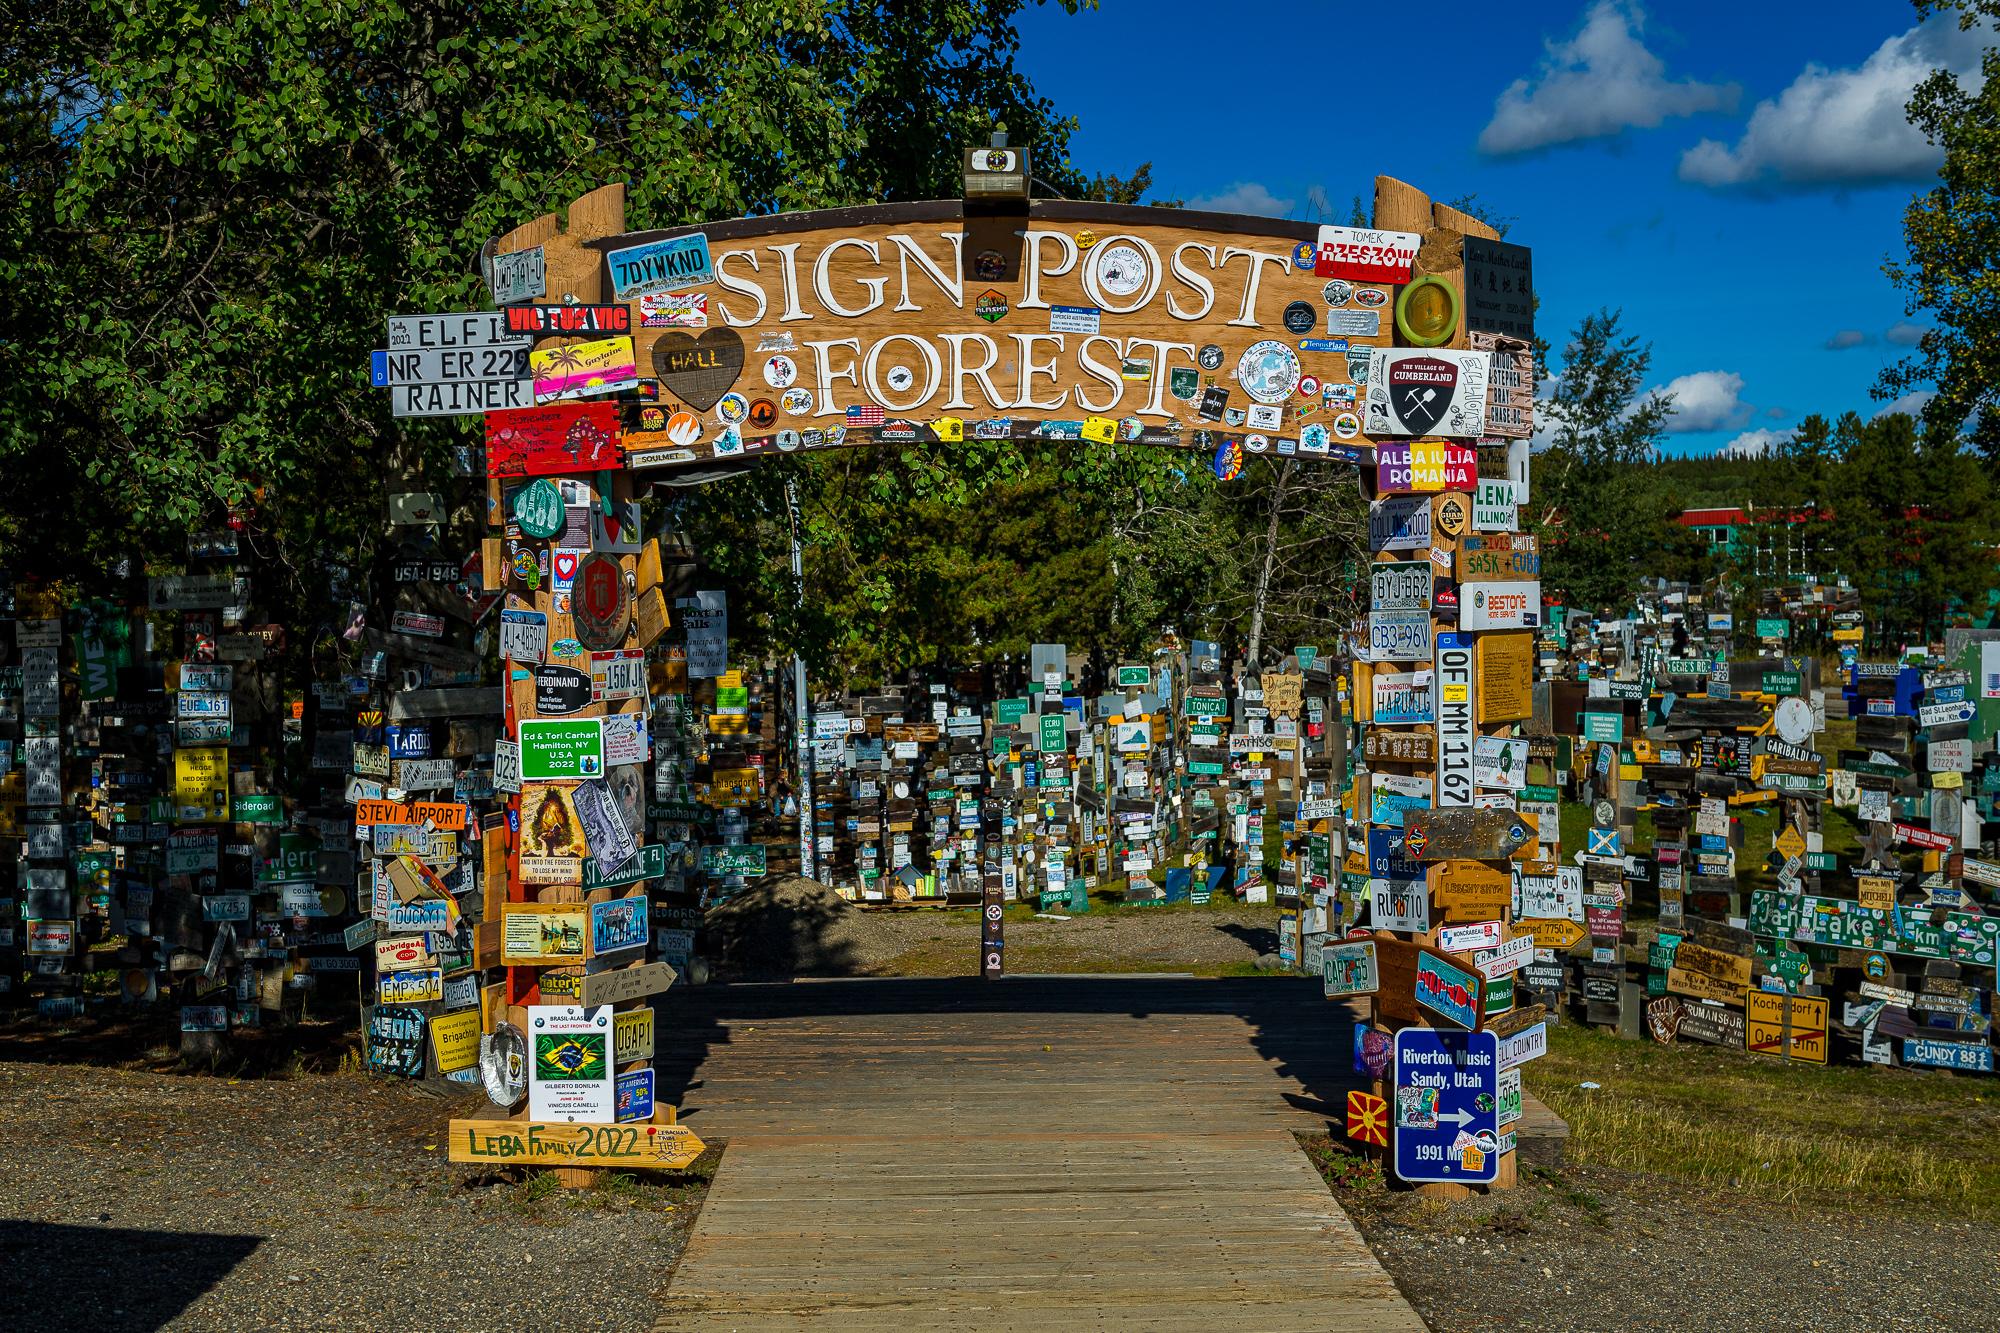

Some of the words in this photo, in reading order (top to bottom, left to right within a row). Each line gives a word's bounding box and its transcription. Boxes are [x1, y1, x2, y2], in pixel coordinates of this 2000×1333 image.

[1351, 231, 1384, 243] TOMEK
[1322, 242, 1415, 268] RZESZÓW
[616, 249, 705, 285] 7DYWKND
[714, 232, 969, 328] SIGN
[1014, 231, 1292, 328] POST
[508, 308, 543, 330] VIC
[594, 307, 627, 330] VIC
[392, 334, 411, 344] 2022
[585, 346, 622, 367] Guylaine
[672, 350, 723, 370] HALL
[378, 372, 382, 380] D
[389, 354, 422, 380] NR
[442, 352, 474, 378] ER
[483, 350, 529, 376] 229
[803, 333, 1196, 418] FOREST
[1394, 372, 1452, 381] CUMBERLAND
[642, 452, 679, 462] SOULMET
[1381, 451, 1426, 464] ALBA
[1432, 451, 1474, 463] IULIA
[1476, 484, 1514, 506] LENA
[1371, 513, 1429, 538] COLLINGWOOD
[1464, 538, 1481, 550] MIKE
[1488, 537, 1510, 550] IVIS
[1512, 536, 1535, 550] WHITE
[1512, 552, 1540, 573] CUBA
[1488, 595, 1527, 609] BESTONE
[504, 626, 515, 651] AJ
[1372, 626, 1398, 648] CB3
[1407, 624, 1430, 646] 96V
[1442, 651, 1468, 682] OF
[1671, 660, 1695, 673] GENE'S
[538, 677, 579, 687] FERDINAND
[607, 663, 643, 689] 156XJA
[1771, 675, 1797, 684] Michigan
[1610, 682, 1642, 692] GREENSBORO
[1625, 691, 1642, 699] 2000
[208, 701, 227, 711] 161
[1192, 702, 1221, 711] TONICA
[1045, 719, 1060, 727] ECRU
[1194, 725, 1211, 734] HAZEL
[181, 727, 201, 739] ESS
[208, 726, 227, 737] 949
[565, 731, 598, 739] Carhart
[1046, 730, 1060, 738] CORP
[392, 733, 430, 750] TARDIS
[1046, 740, 1060, 748] LIMIT
[1767, 740, 1810, 761] GARIBALDI
[1622, 753, 1631, 763] WA
[1443, 742, 1469, 803] 1167
[235, 801, 274, 812] Sideroad
[648, 805, 699, 818] Grimshaw
[359, 804, 397, 821] STEVI
[406, 806, 462, 824] AIRPORT
[431, 842, 455, 856] 4779
[651, 850, 660, 862] FL
[1376, 858, 1389, 872] GO
[1392, 859, 1421, 873] HEELS
[1701, 864, 1728, 874] ECHING
[1043, 892, 1059, 901] SHEARS
[1861, 892, 1892, 902] MITCHELL
[1542, 904, 1565, 912] LIMIT
[1759, 902, 1798, 927] Jan
[1813, 907, 1874, 937] Lake
[1545, 924, 1563, 934] 7750
[1566, 926, 1573, 934] km
[1915, 927, 1940, 946] km
[1475, 937, 1533, 965] CHALESGLEN
[1497, 958, 1519, 971] TOYOTA
[1525, 967, 1562, 976] BLAIRSVILLE
[1685, 973, 1705, 985] KEVIN
[418, 980, 440, 996] 504
[1705, 986, 1731, 997] MANITOBA
[1490, 991, 1506, 1002] Alaska
[1753, 996, 1812, 1015] Kochedorf
[442, 1029, 477, 1043] Brigachtal
[1755, 1029, 1818, 1052] Oedeim
[1514, 1032, 1544, 1056] COUNTRY
[1403, 1049, 1453, 1064] Riverton
[1456, 1050, 1491, 1066] Music
[1915, 1045, 1956, 1062] CUNDY
[1960, 1050, 1977, 1064] 88
[625, 1078, 649, 1088] AMERICA
[1411, 1071, 1451, 1089] Sandy,
[1454, 1073, 1482, 1088] Utah
[468, 1128, 527, 1157] LEBA
[528, 1125, 576, 1157] FAMILY
[576, 1127, 642, 1157] 2022
[657, 1141, 685, 1150] TIBET
[1416, 1145, 1443, 1161] 1991
